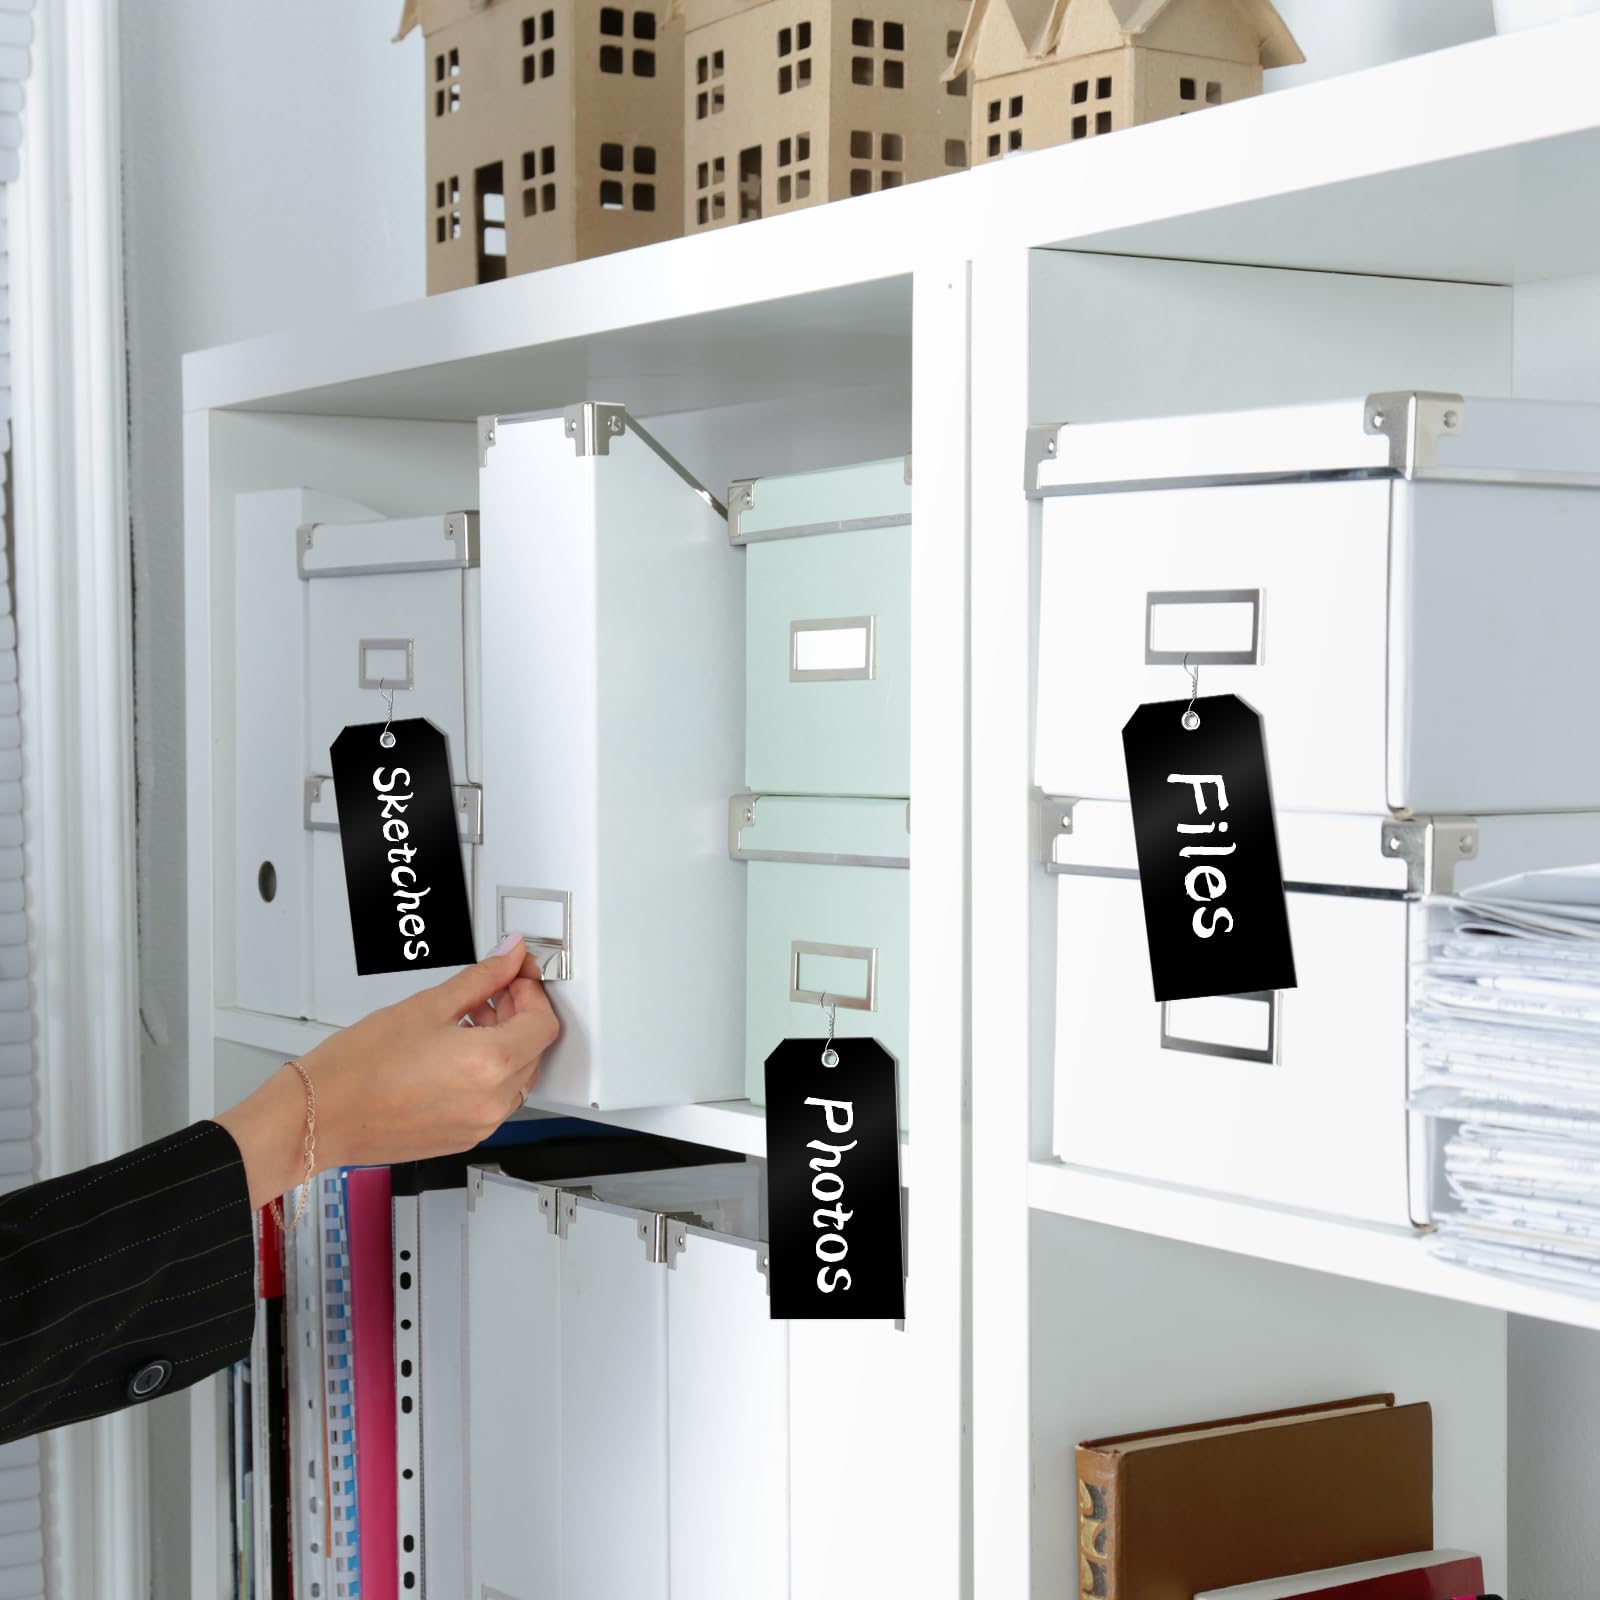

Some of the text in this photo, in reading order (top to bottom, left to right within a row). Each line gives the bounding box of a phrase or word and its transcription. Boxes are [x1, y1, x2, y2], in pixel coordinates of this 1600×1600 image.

[373, 767, 431, 961] Sketches
[1167, 774, 1237, 939] Files
[804, 1097, 858, 1294] Photos
